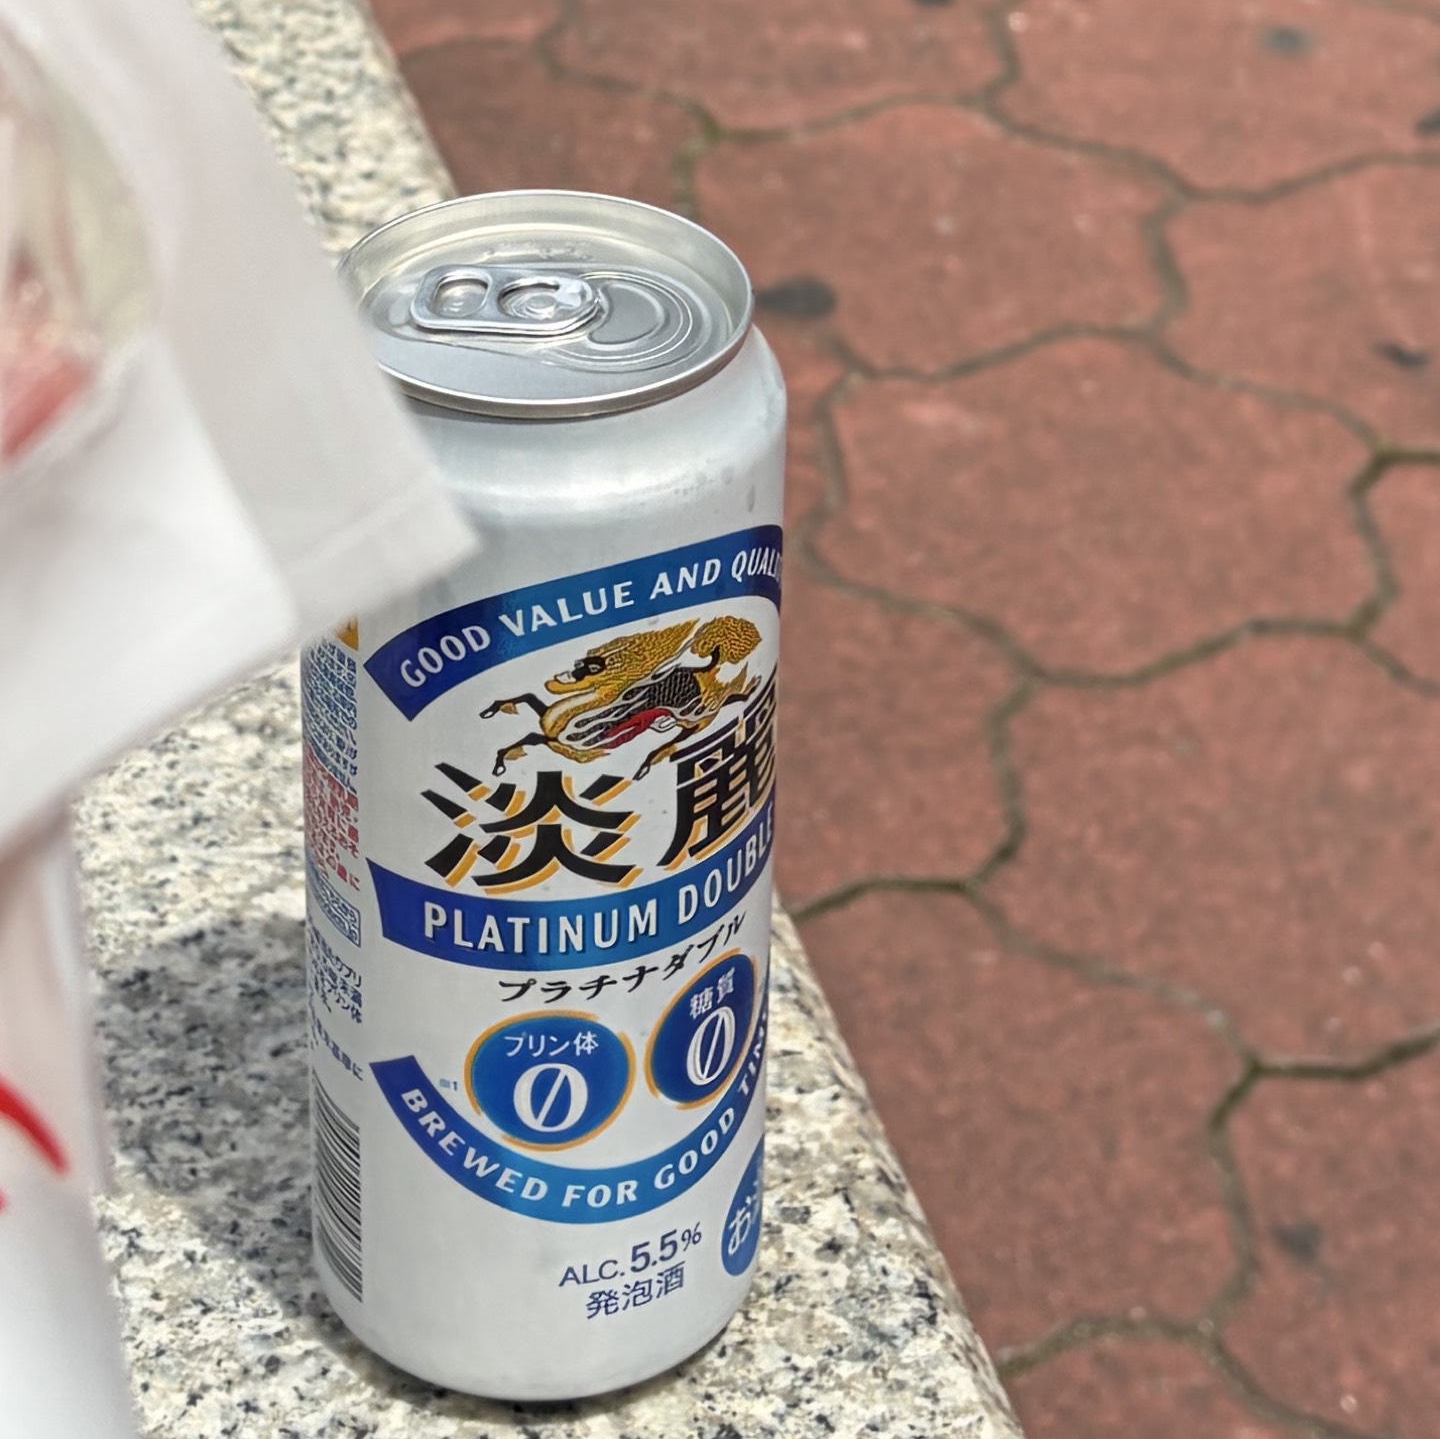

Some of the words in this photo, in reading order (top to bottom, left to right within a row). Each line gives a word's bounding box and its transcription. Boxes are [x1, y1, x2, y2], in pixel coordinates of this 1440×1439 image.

[400, 624, 491, 689] GOOD
[498, 580, 635, 637] VALUE
[649, 558, 721, 602] AND
[424, 899, 658, 955] PLATINUM
[498, 910, 747, 1003] プラチナダブル
[689, 967, 736, 1019] 糖質
[504, 1031, 600, 1058] プリン体
[402, 1088, 549, 1202] BREWED
[562, 1179, 639, 1208] FOR
[654, 1107, 736, 1190] GOOD
[585, 1261, 686, 1321] 発泡酒
